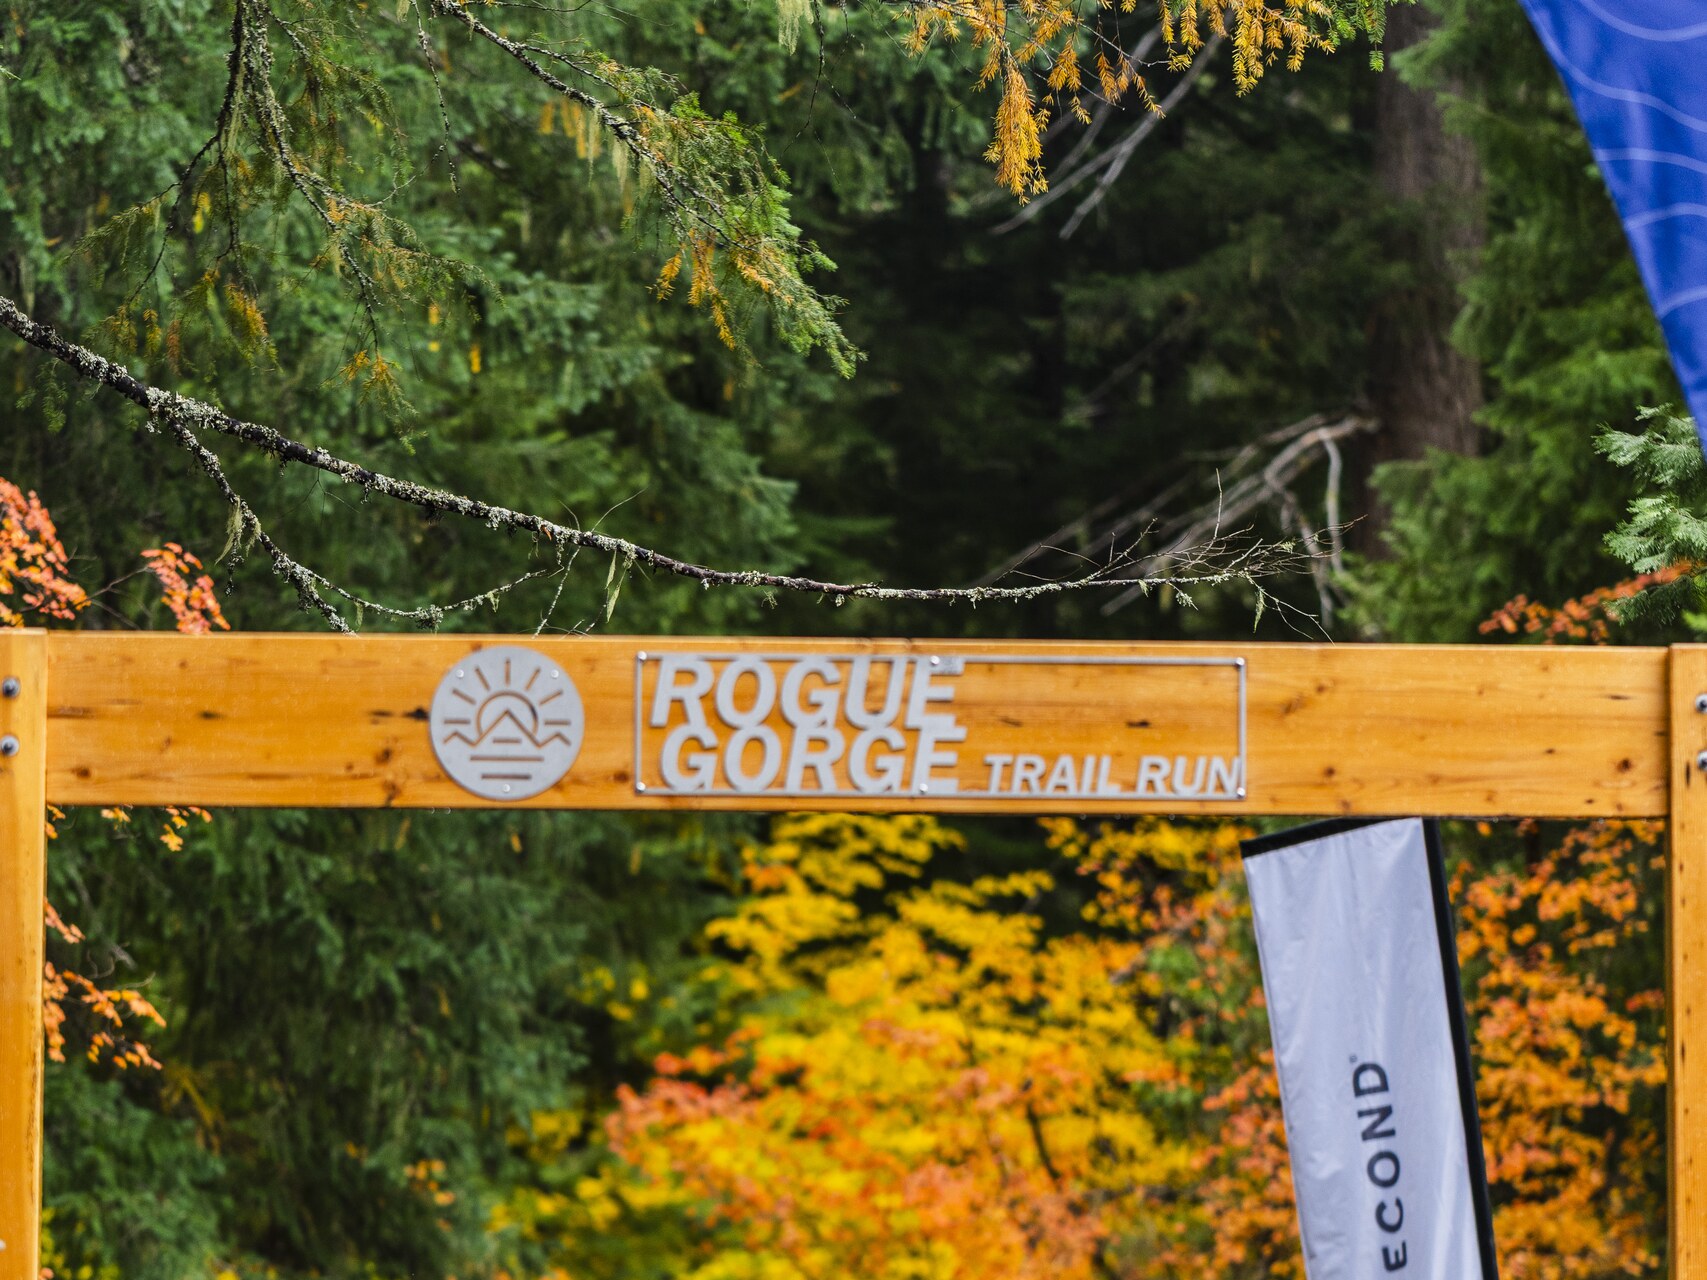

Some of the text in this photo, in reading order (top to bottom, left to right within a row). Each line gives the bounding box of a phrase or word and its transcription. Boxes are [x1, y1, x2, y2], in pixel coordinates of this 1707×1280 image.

[650, 655, 965, 731] ROGUE
[660, 724, 1242, 796] GORGE TRAIL RUN
